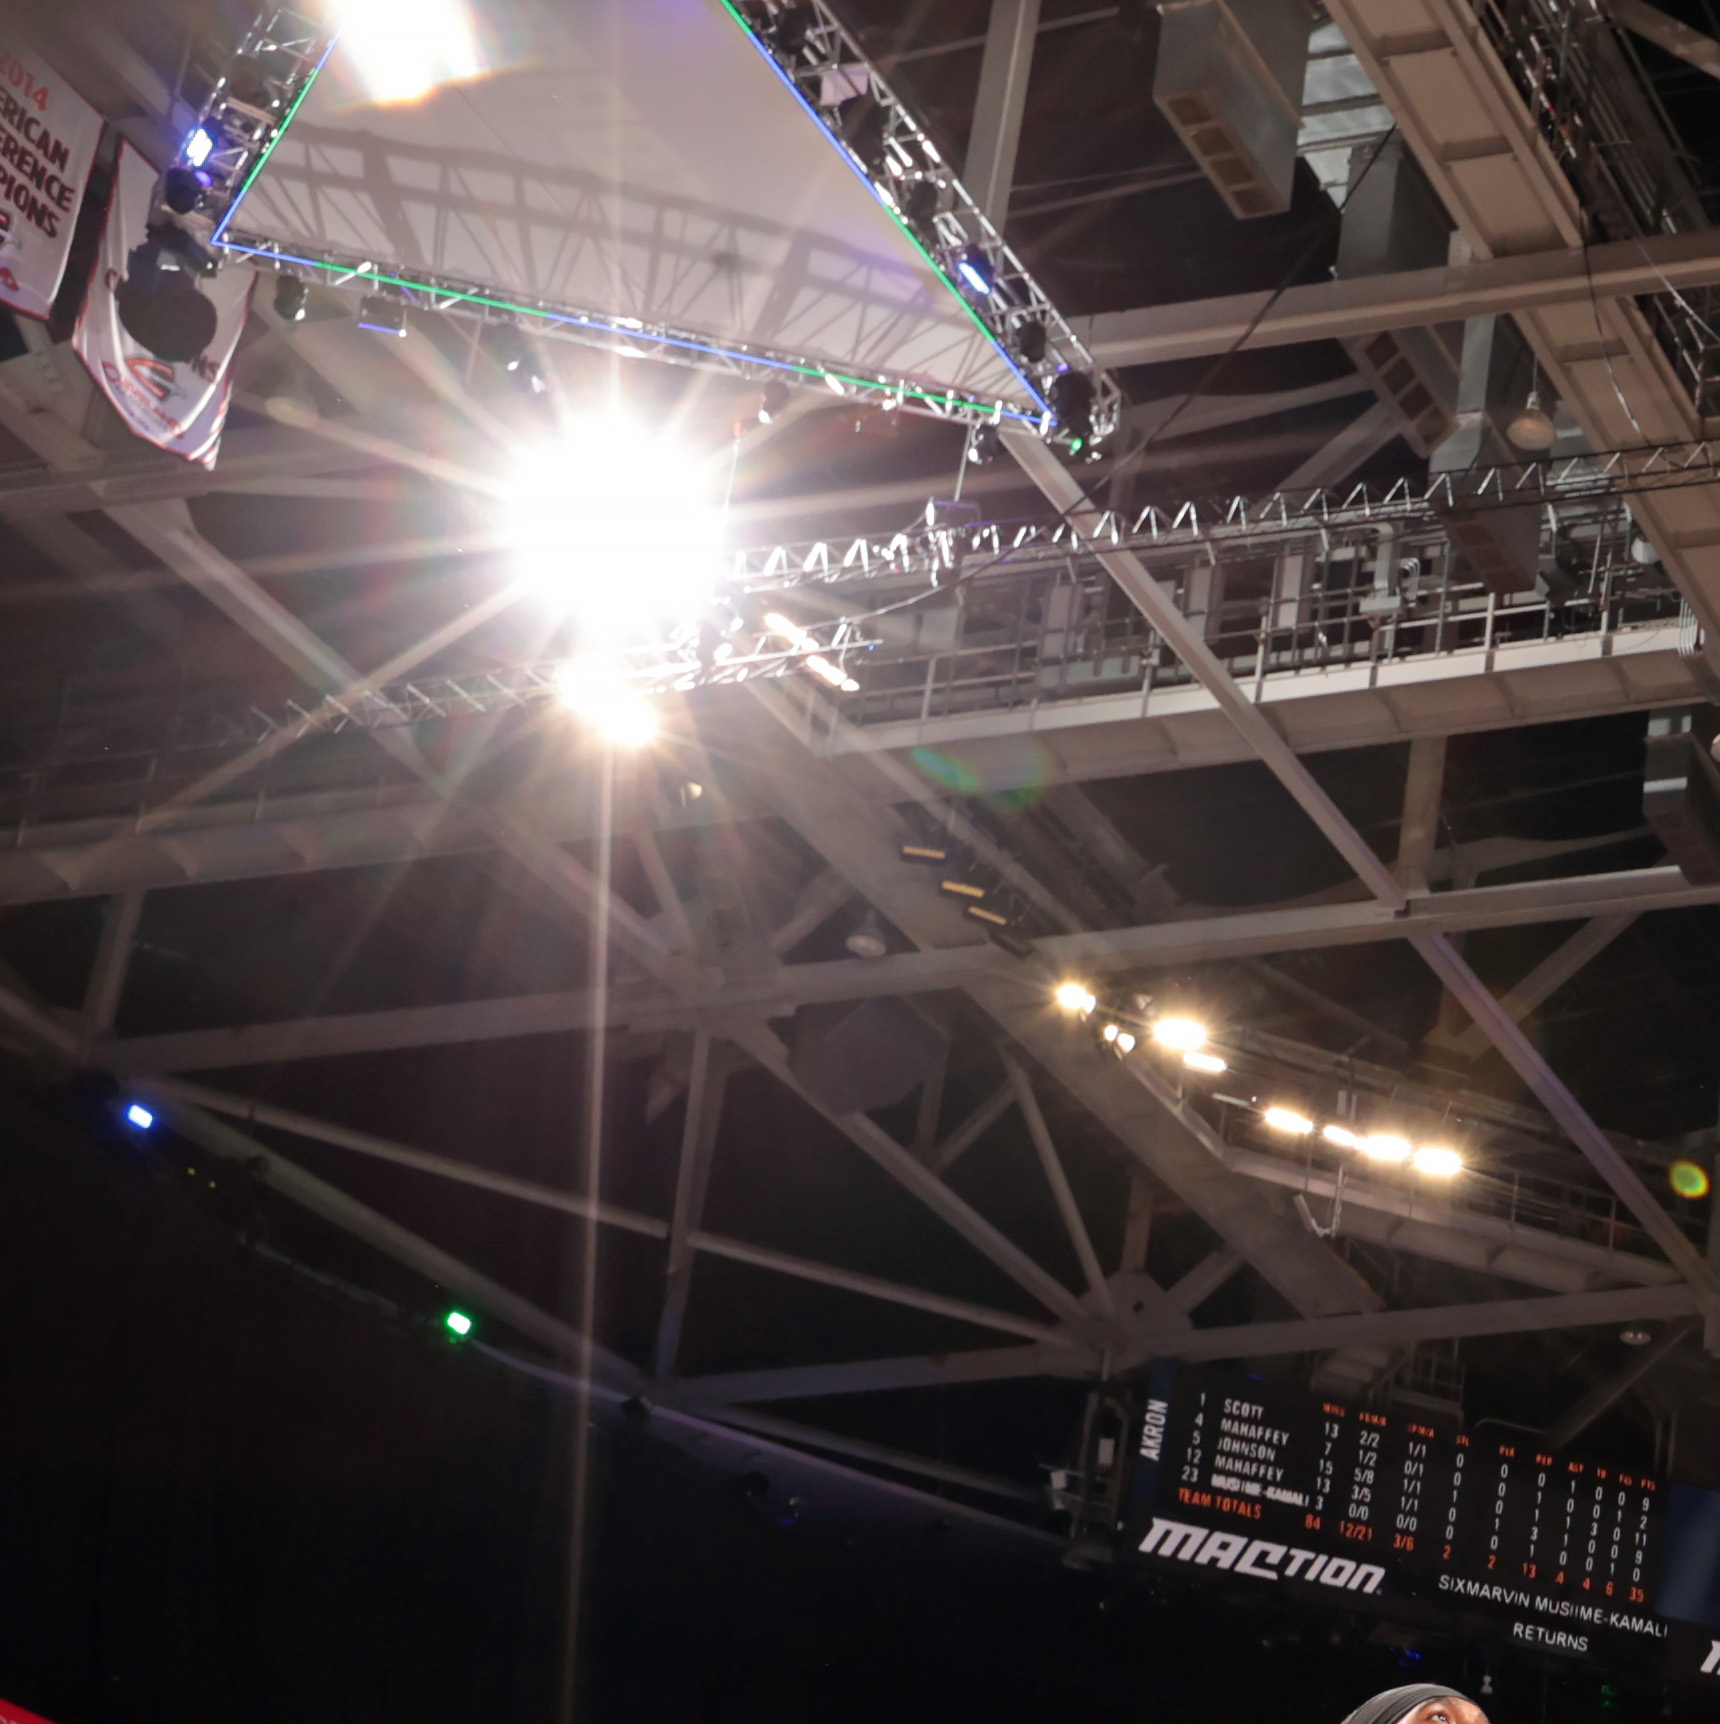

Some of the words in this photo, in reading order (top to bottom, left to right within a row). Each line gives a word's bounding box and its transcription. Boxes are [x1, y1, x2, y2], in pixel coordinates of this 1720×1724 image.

[1140, 1398, 1169, 1462] AKRON
[1223, 1397, 1265, 1420] SCOTT
[1324, 1421, 1340, 1440] 13
[1359, 1430, 1381, 1449] 2/2
[1185, 1447, 1201, 1465] 12
[1214, 1453, 1284, 1483] MAHAFFEY
[1316, 1476, 1332, 1495] 13
[1192, 1430, 1201, 1446] 5
[1216, 1435, 1277, 1463] JOHNSON
[1318, 1459, 1334, 1476] 15
[1194, 1412, 1205, 1428] 4
[1220, 1417, 1290, 1447] MAHAFFEY
[1324, 1442, 1333, 1456] 7
[1357, 1450, 1378, 1468] 1/2
[1639, 1515, 1648, 1530] 2
[1177, 1486, 1212, 1509] TEAM
[1215, 1495, 1263, 1521] TOTALS
[1180, 1466, 1199, 1483] 23
[1314, 1495, 1325, 1511] 3
[1138, 1516, 1386, 1595] MACTION
[1437, 1573, 1531, 1609] SIXMARVIN
[1512, 1621, 1590, 1653] RETURNS
